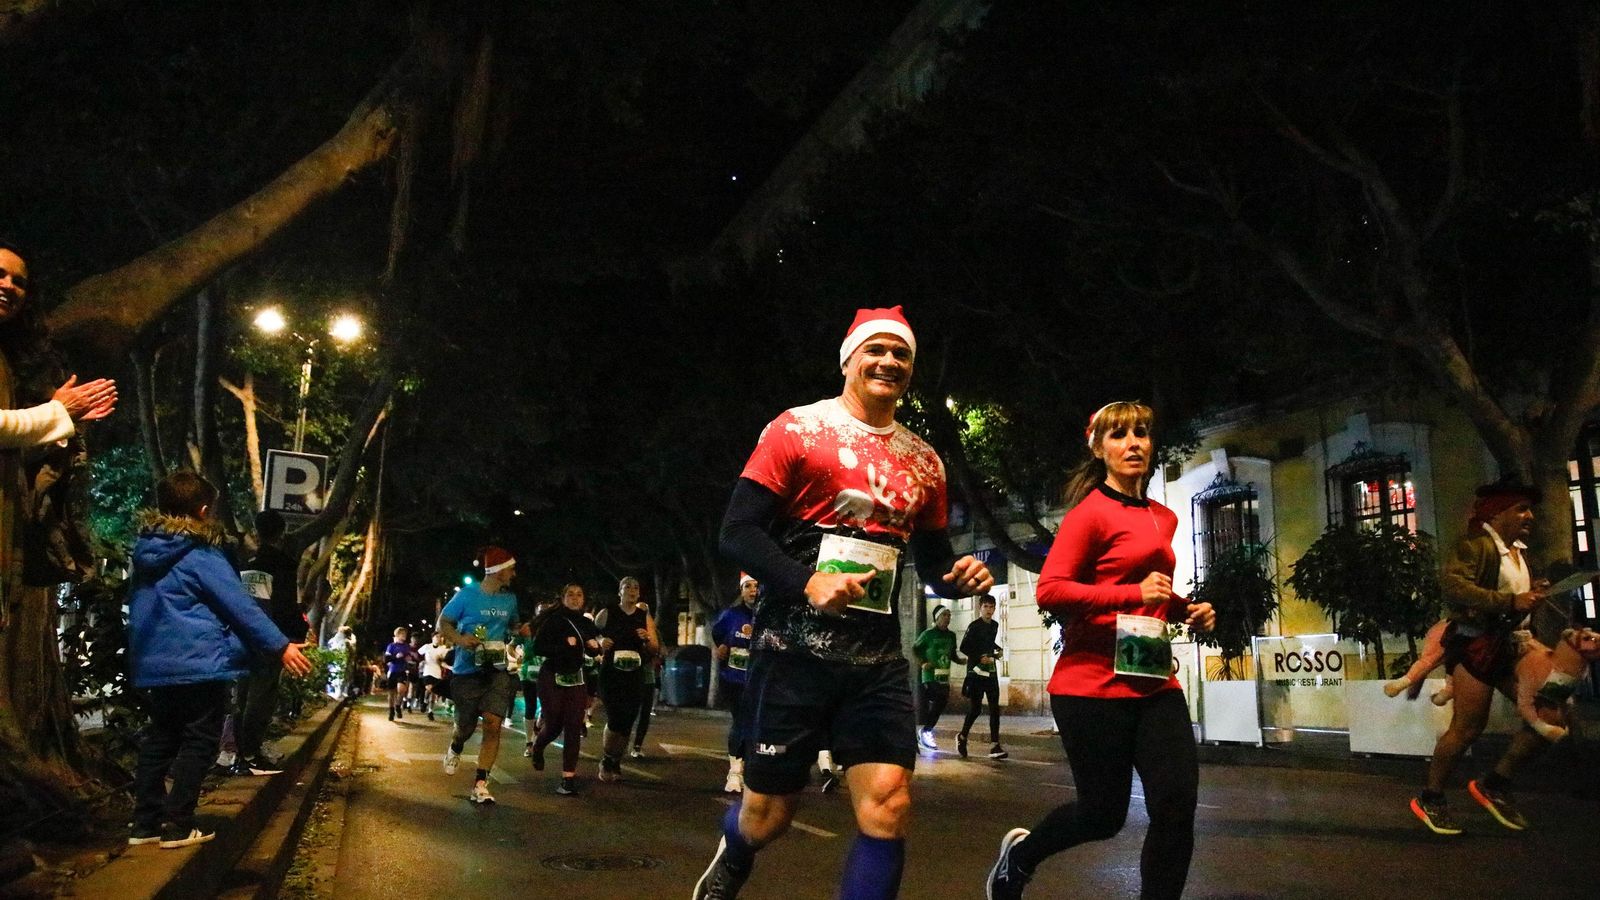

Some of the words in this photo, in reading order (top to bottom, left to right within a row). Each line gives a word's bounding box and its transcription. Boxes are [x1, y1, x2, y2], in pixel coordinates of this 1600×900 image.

[269, 454, 321, 510] P
[1274, 650, 1343, 673] ROSSO
[1276, 678, 1296, 687] MUSIC
